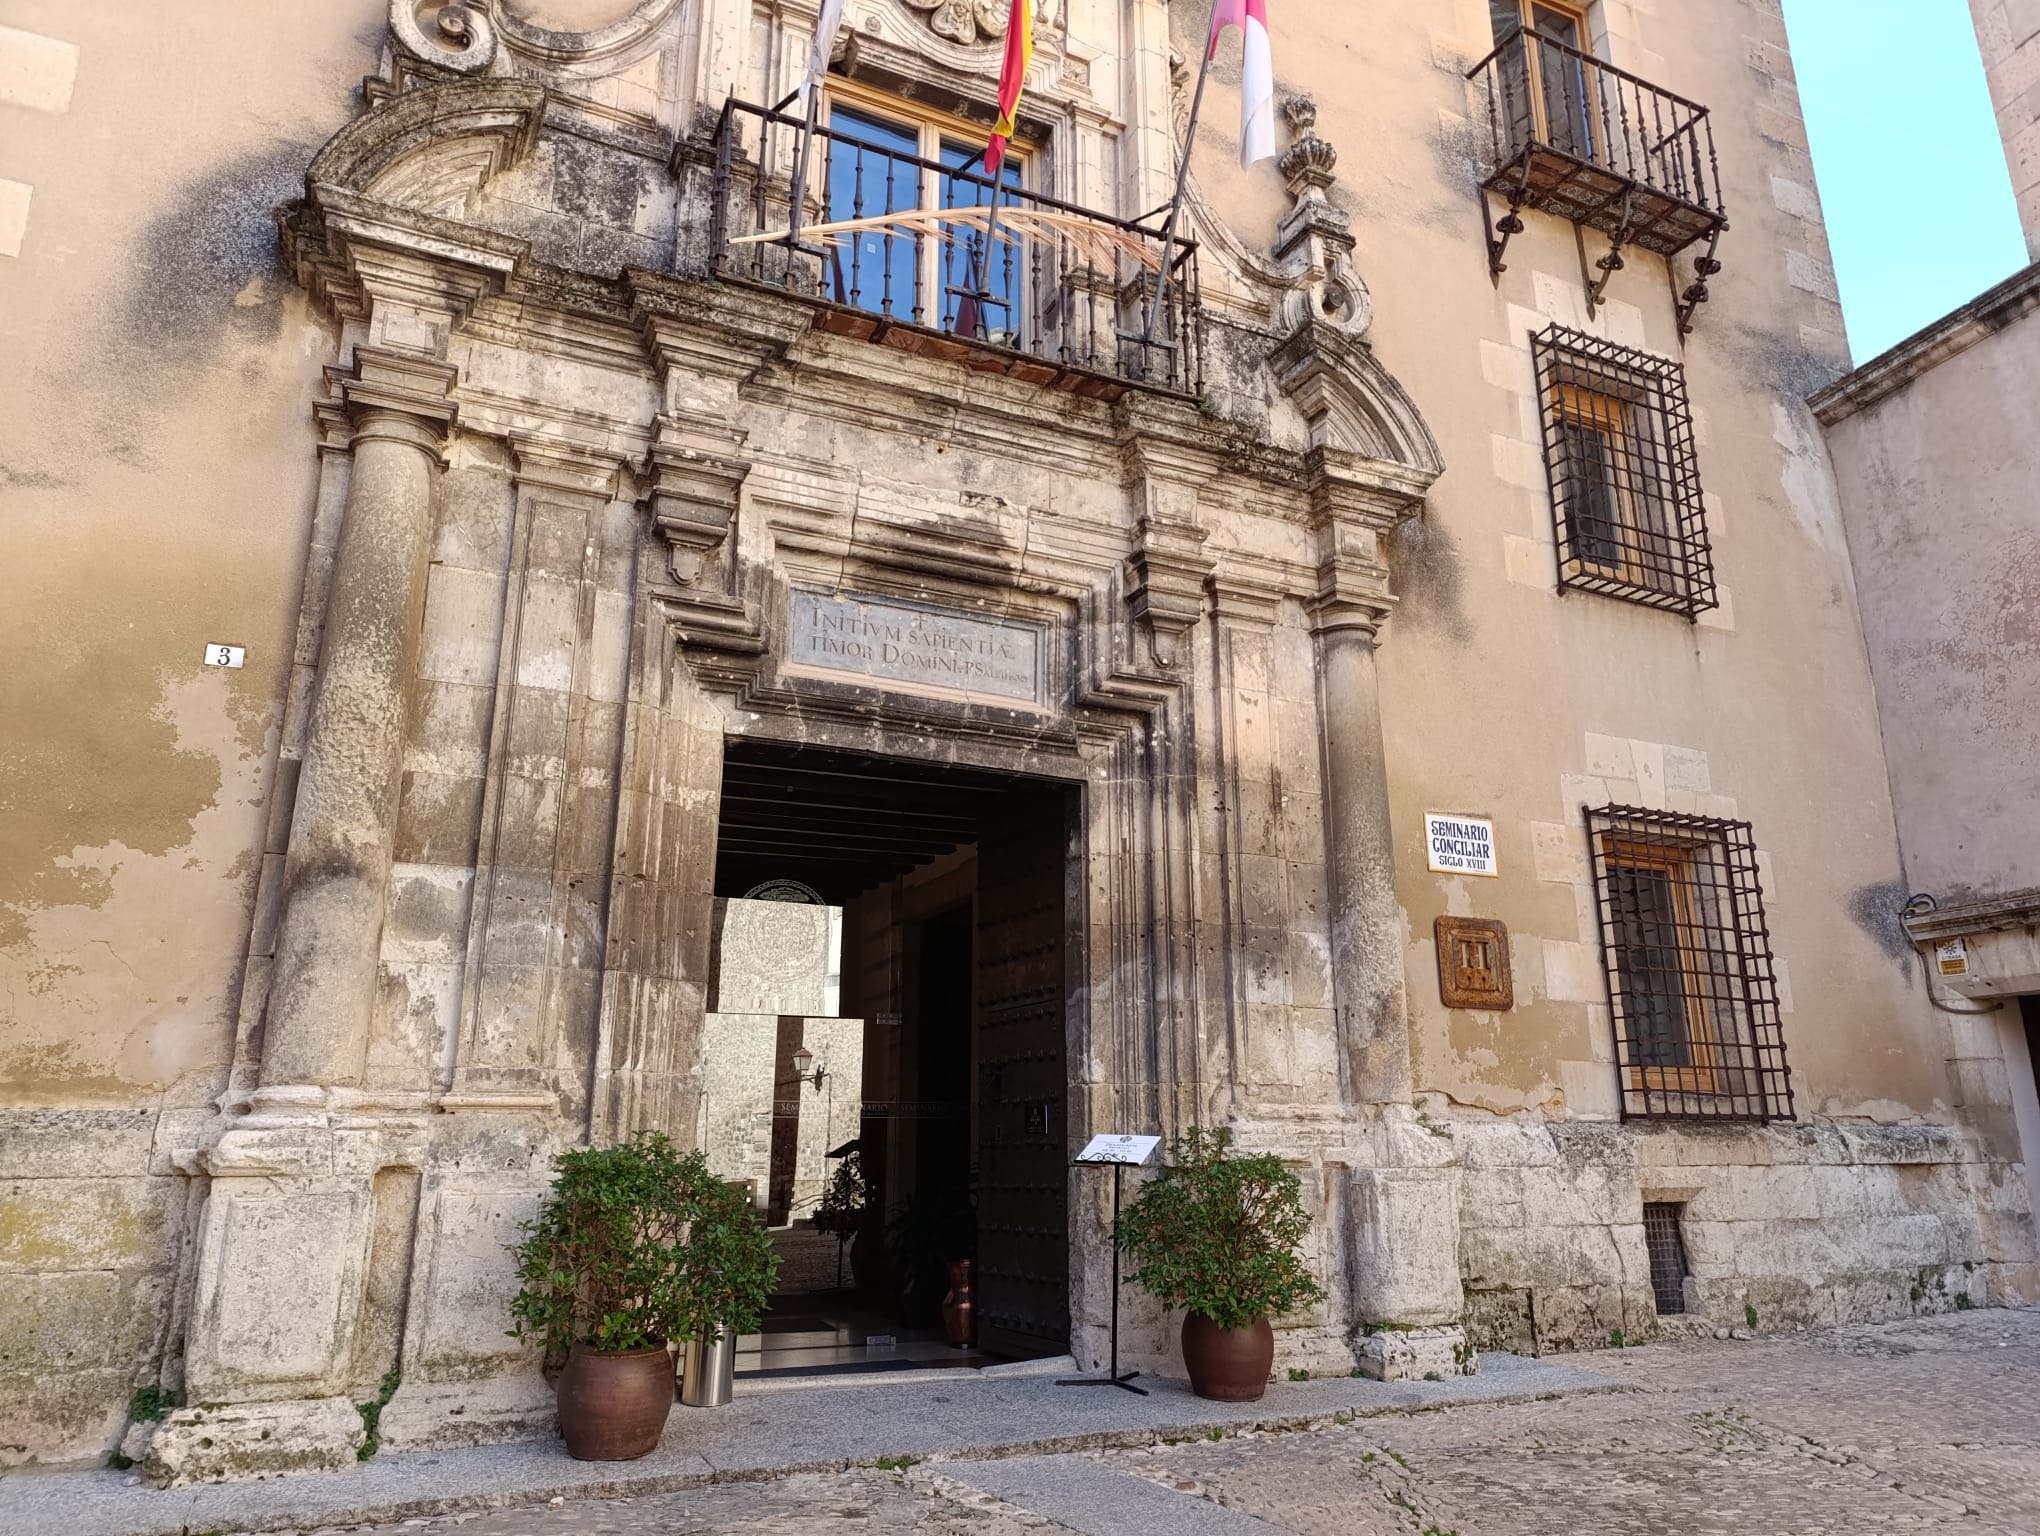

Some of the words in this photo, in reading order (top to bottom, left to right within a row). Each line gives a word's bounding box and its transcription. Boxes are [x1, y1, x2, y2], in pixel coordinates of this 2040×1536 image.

[217, 647, 230, 665] 3
[807, 633, 872, 660] TIMOR
[1431, 820, 1488, 842] SEMINARIO
[1432, 837, 1490, 859] CONCILIAR
[1466, 858, 1486, 870] XVIII
